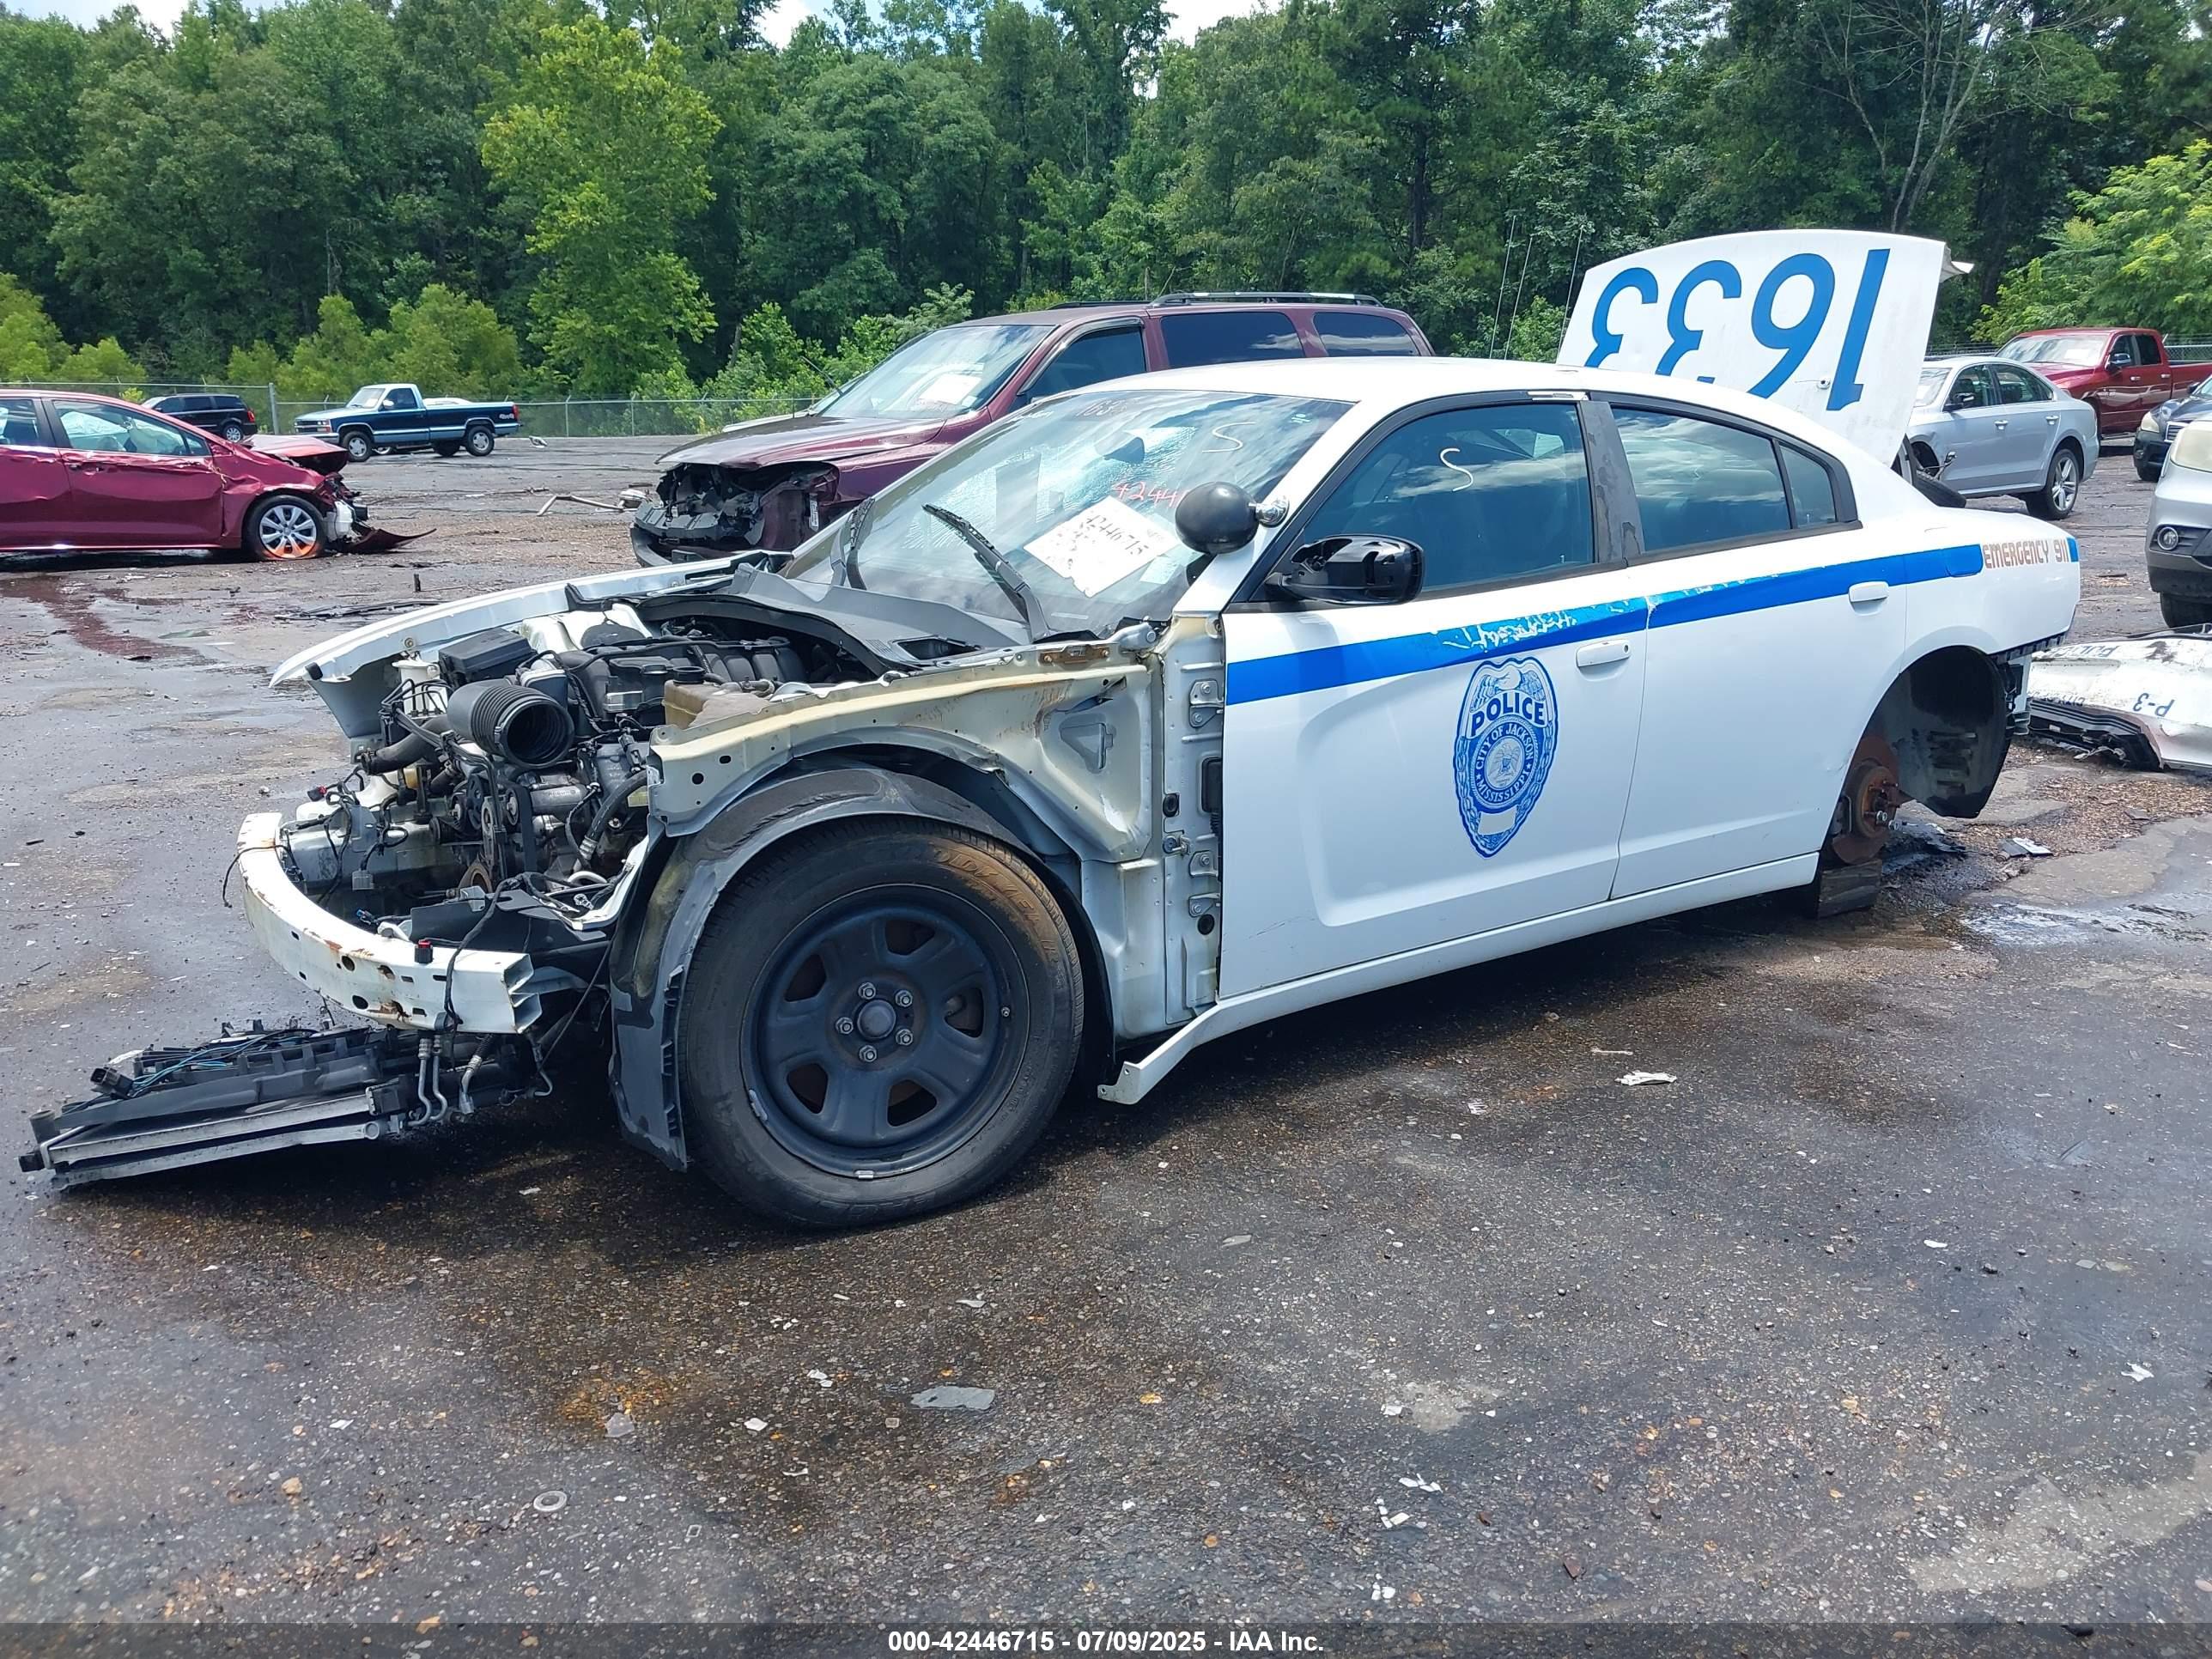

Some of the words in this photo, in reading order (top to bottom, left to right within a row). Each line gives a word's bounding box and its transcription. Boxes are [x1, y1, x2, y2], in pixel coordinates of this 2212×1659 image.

[1584, 247, 1892, 411] 1633
[1984, 540, 2049, 568] EMERGENCY
[1471, 693, 1545, 737] POLICE
[2133, 691, 2176, 718] P-3
[1476, 738, 1492, 770] CITY
[1492, 728, 1504, 740] OF
[1505, 723, 1534, 760] JACKSON
[1475, 769, 1530, 804] MISSISSIPPI
